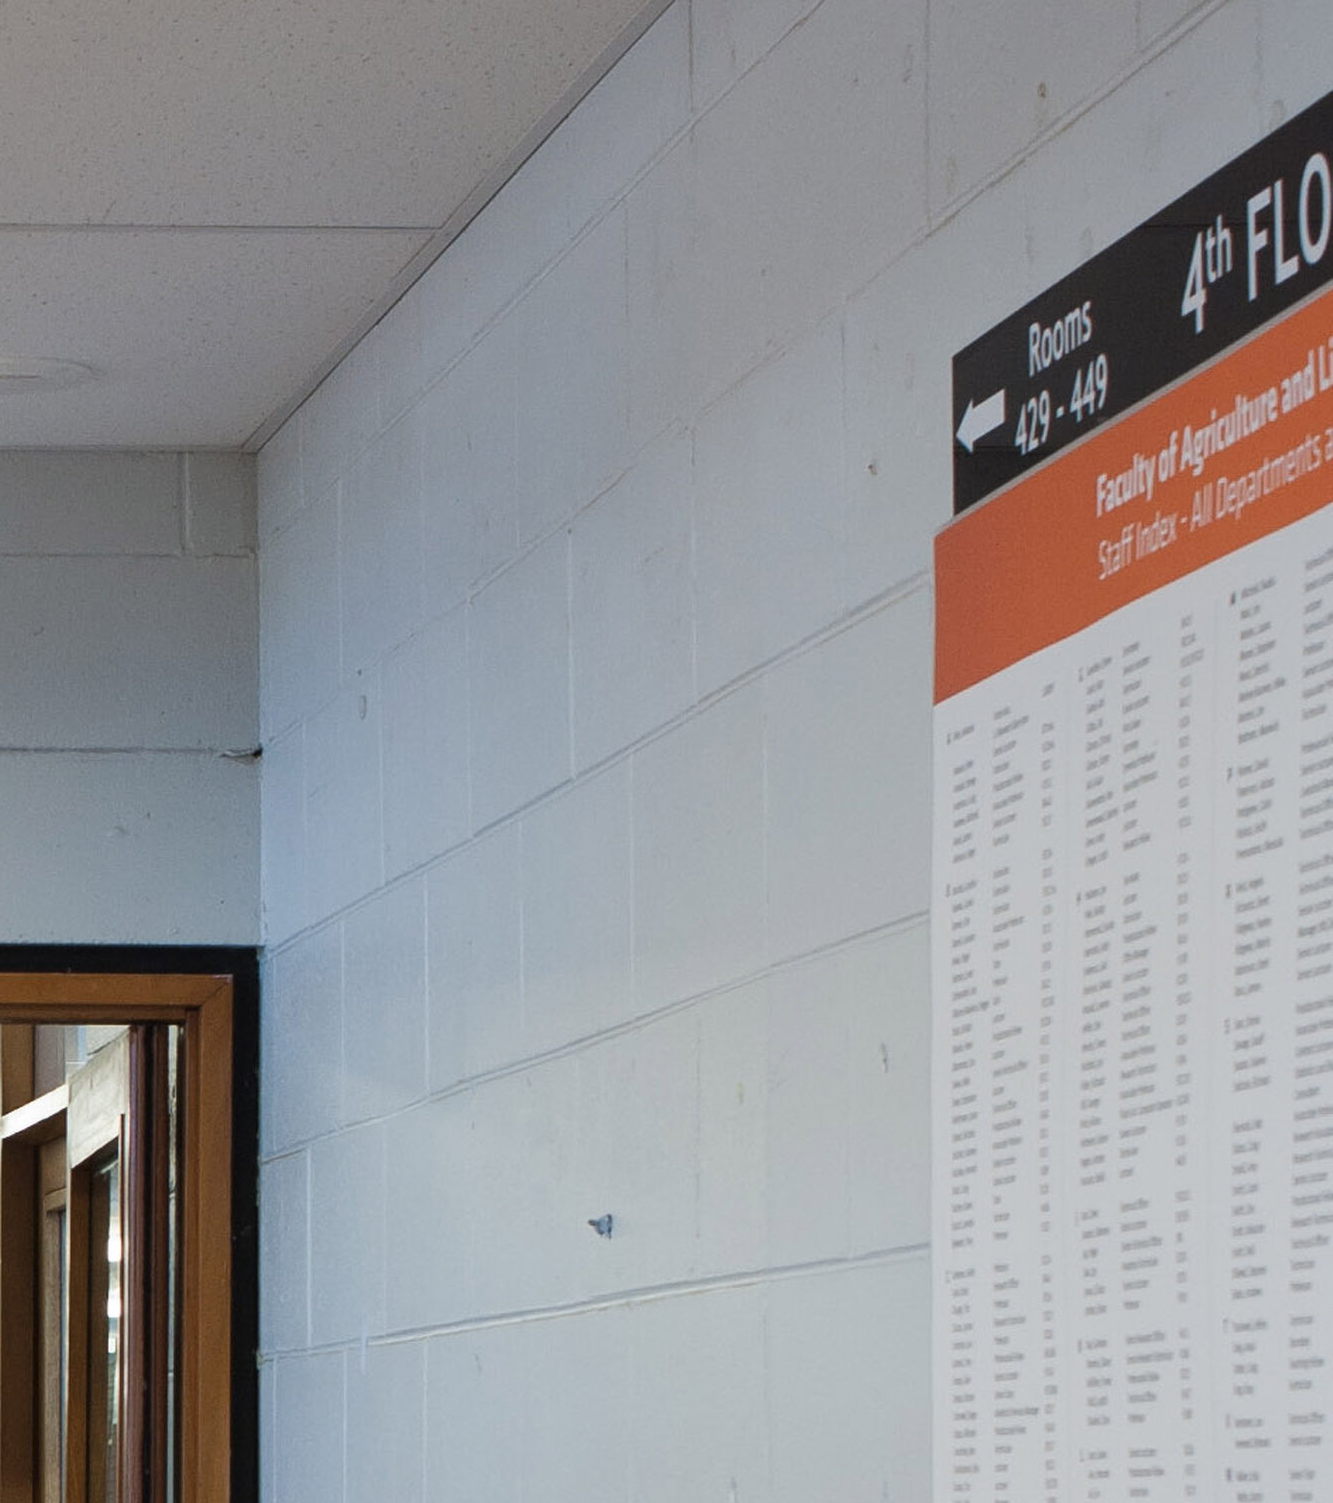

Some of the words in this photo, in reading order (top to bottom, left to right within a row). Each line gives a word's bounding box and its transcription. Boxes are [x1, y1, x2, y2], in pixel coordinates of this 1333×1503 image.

[1180, 213, 1234, 335] 4th
[1246, 152, 1332, 303] FLO
[1014, 389, 1051, 456] 429
[1069, 352, 1109, 424] 449
[1028, 300, 1093, 378] Rooms
[1095, 451, 1156, 518] Faculty
[1158, 431, 1178, 482] of
[1179, 385, 1279, 477] Agriculture
[1281, 351, 1315, 414] and
[1098, 522, 1135, 581] Staff
[1135, 509, 1177, 559] Index
[1189, 481, 1213, 532] All
[1215, 433, 1321, 522] Departments
